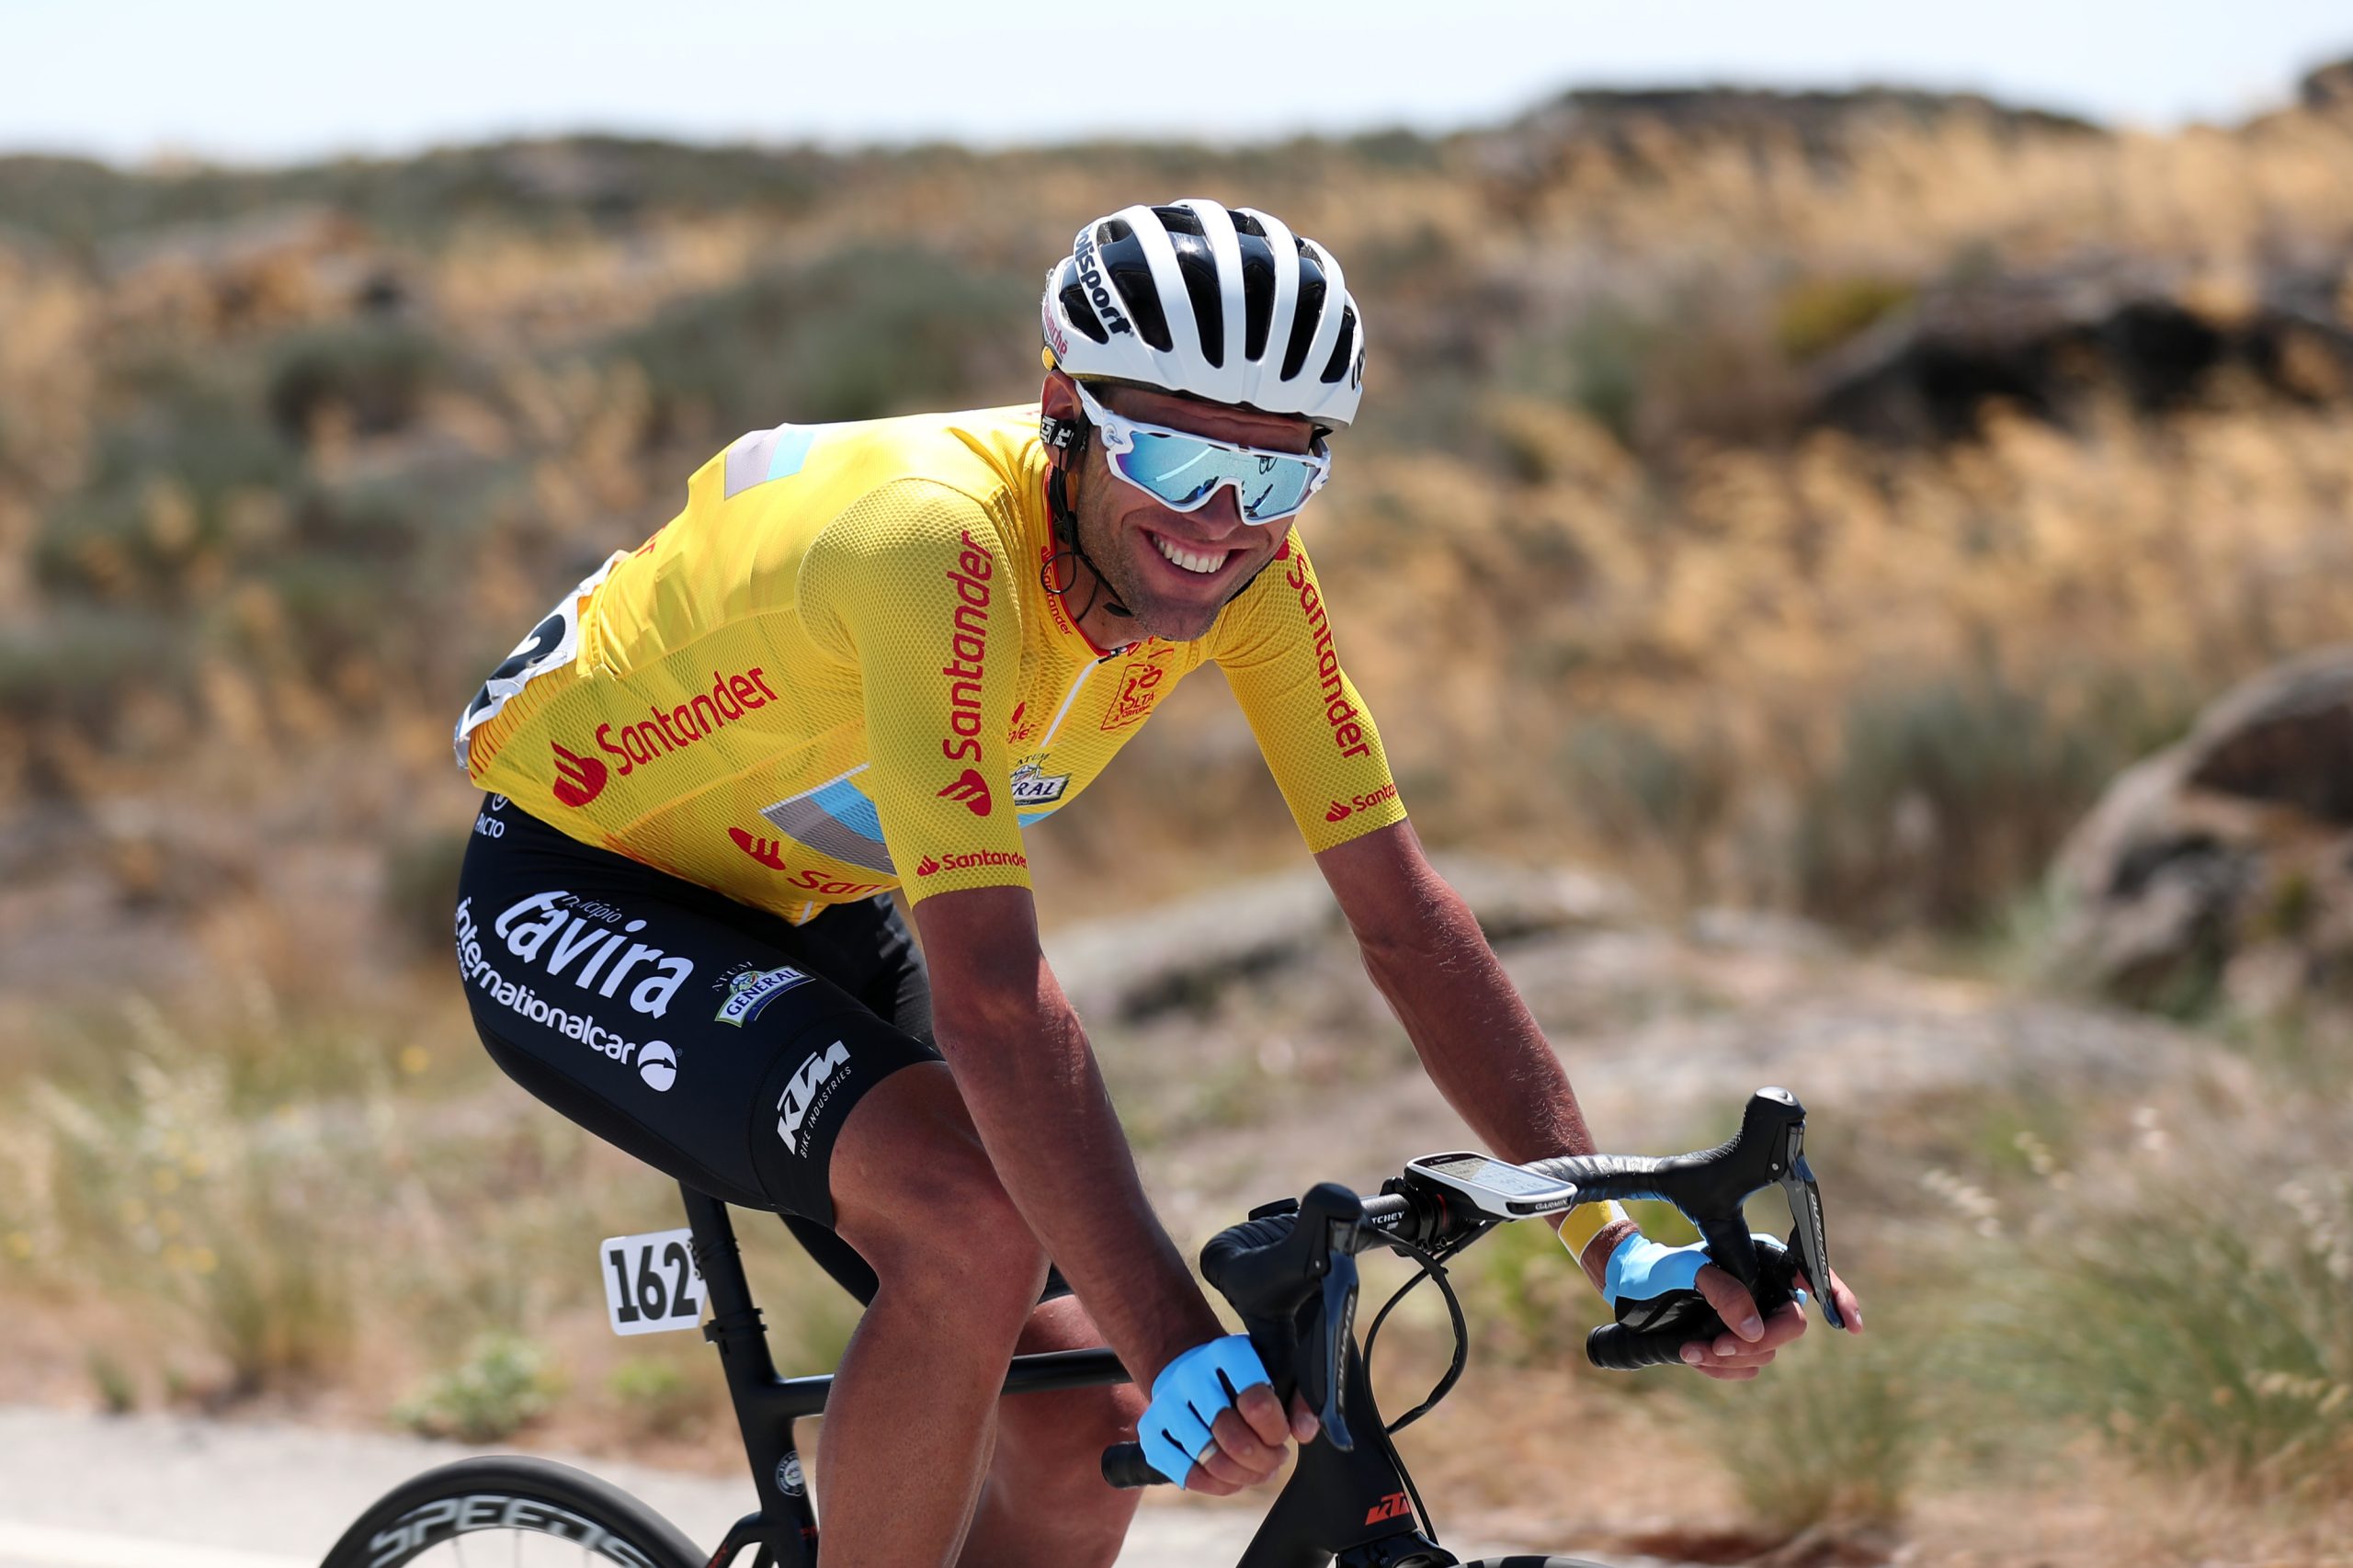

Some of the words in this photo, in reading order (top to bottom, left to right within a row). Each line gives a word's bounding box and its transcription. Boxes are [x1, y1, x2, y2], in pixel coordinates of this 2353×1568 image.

[1041, 565, 1074, 637] Santander
[942, 530, 995, 762] Santander
[1287, 553, 1370, 758] Santander
[595, 666, 779, 777] Santander
[942, 848, 1028, 870] Santander
[726, 970, 801, 1016] GENERAL
[777, 1040, 851, 1155] KTM
[800, 1130, 812, 1159] BIKE
[808, 1066, 852, 1129] INDUSTRIES
[1535, 1198, 1568, 1210] GARMIN
[609, 1242, 699, 1324] 162
